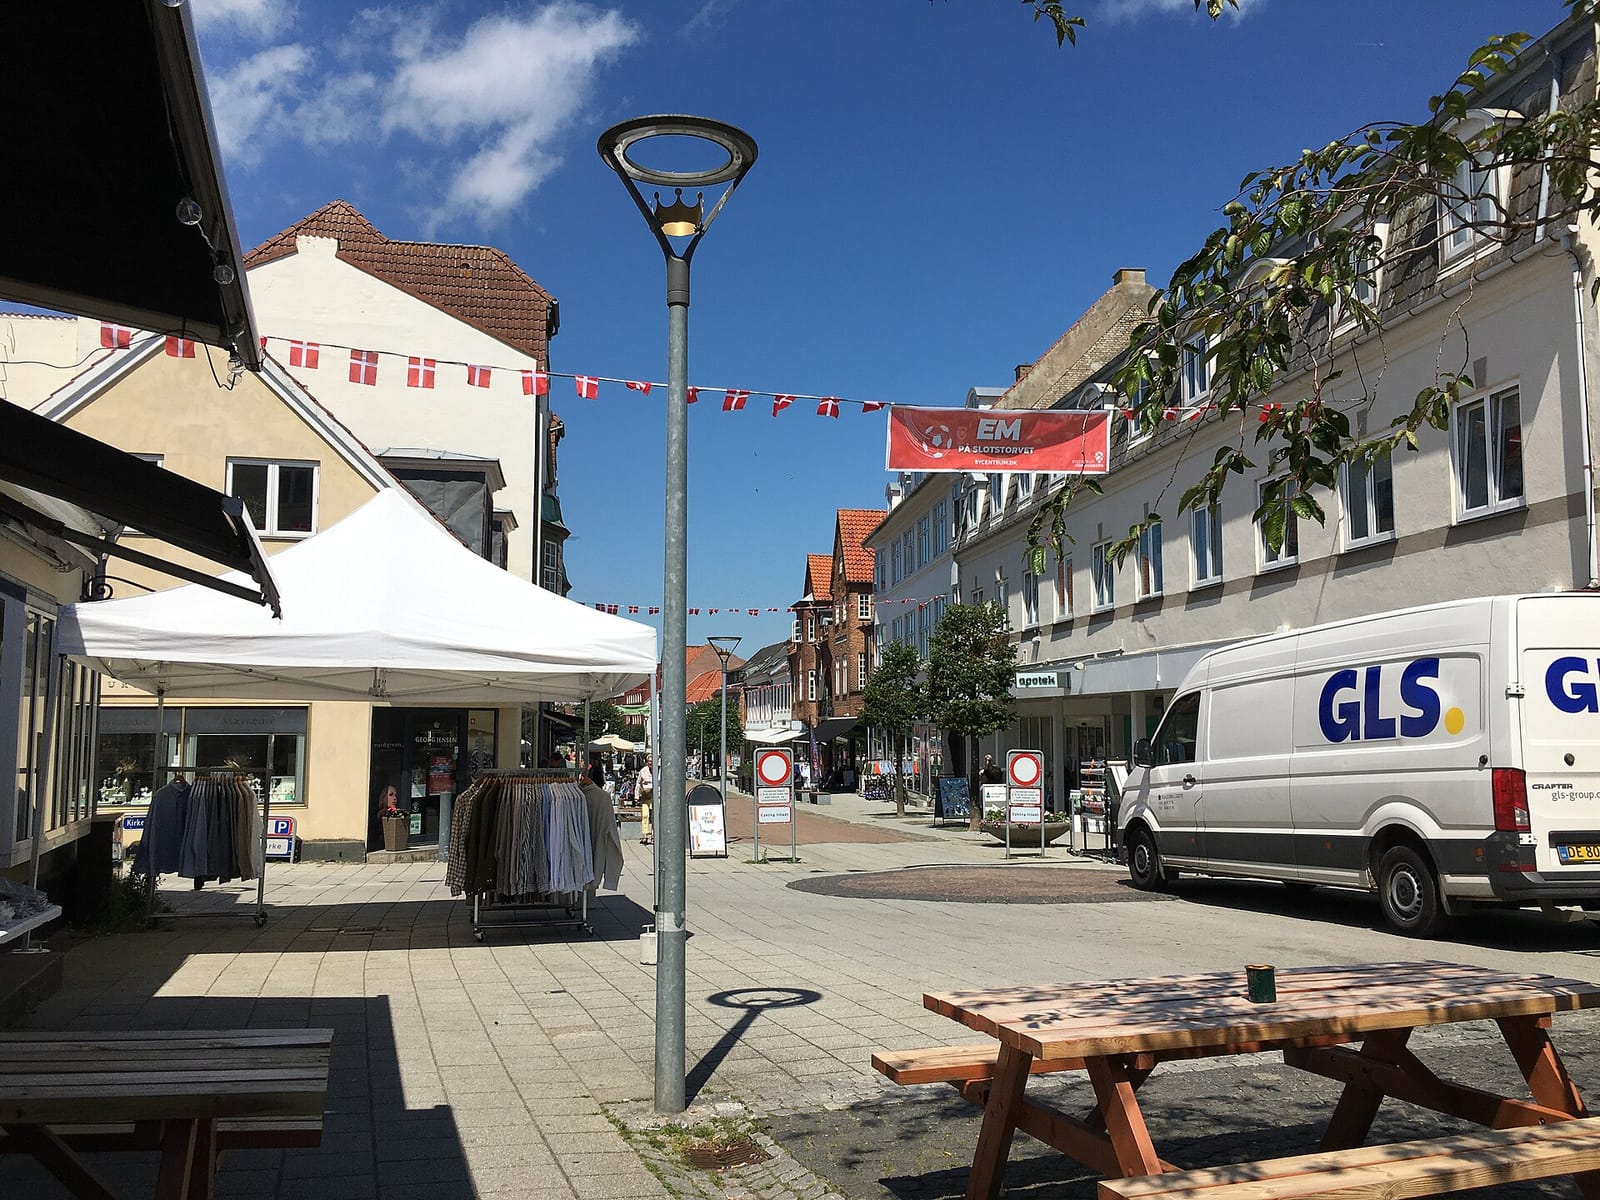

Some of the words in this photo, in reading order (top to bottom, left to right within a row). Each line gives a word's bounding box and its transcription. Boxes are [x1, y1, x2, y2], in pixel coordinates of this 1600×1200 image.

[976, 418, 1022, 441] EM
[958, 442, 971, 453] PÅ
[972, 445, 1035, 454] SLOTSTORVET
[1018, 675, 1056, 688] apotek
[1545, 656, 1600, 714] G
[1318, 657, 1441, 743] GLS
[1567, 846, 1585, 858] DE
